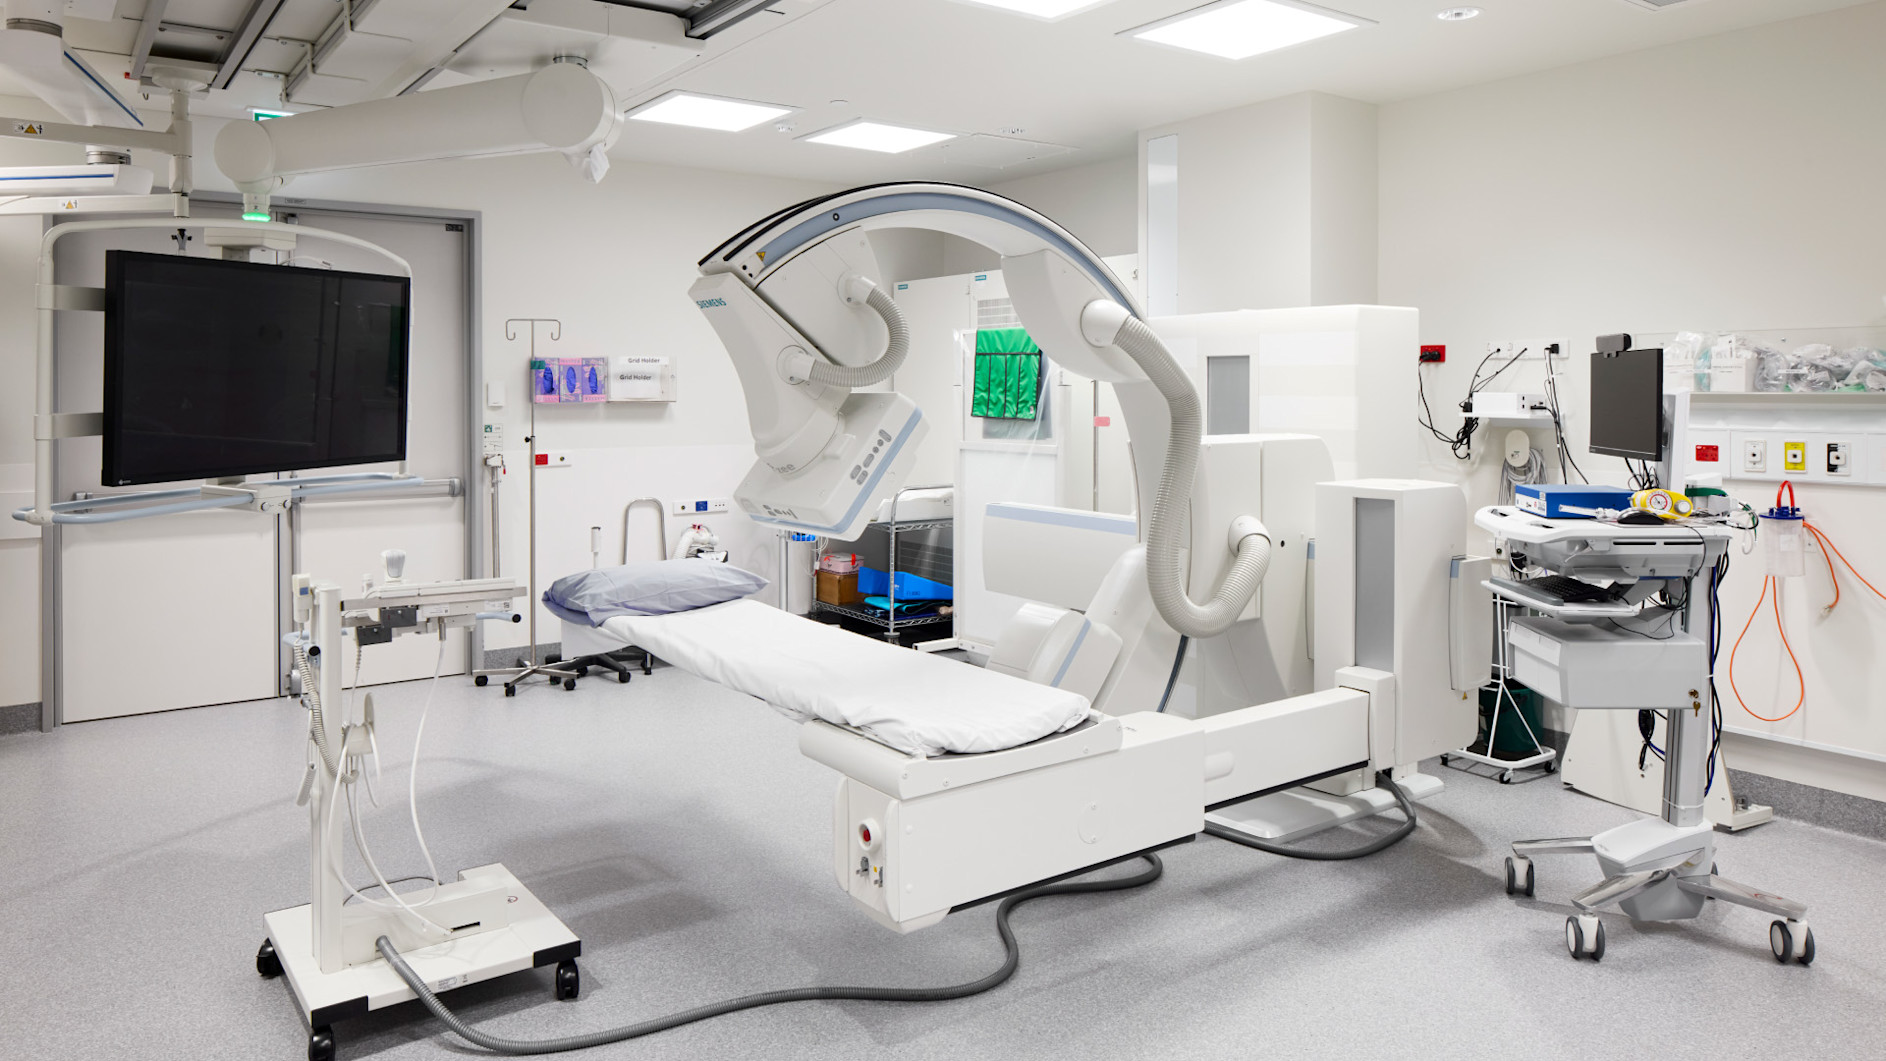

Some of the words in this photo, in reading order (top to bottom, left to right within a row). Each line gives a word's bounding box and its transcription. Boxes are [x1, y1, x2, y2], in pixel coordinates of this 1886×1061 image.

[696, 297, 727, 309] SIEMENS
[627, 356, 640, 364] Grid
[641, 356, 660, 364] Holder
[619, 373, 632, 381] Grid
[633, 373, 652, 381] Holder
